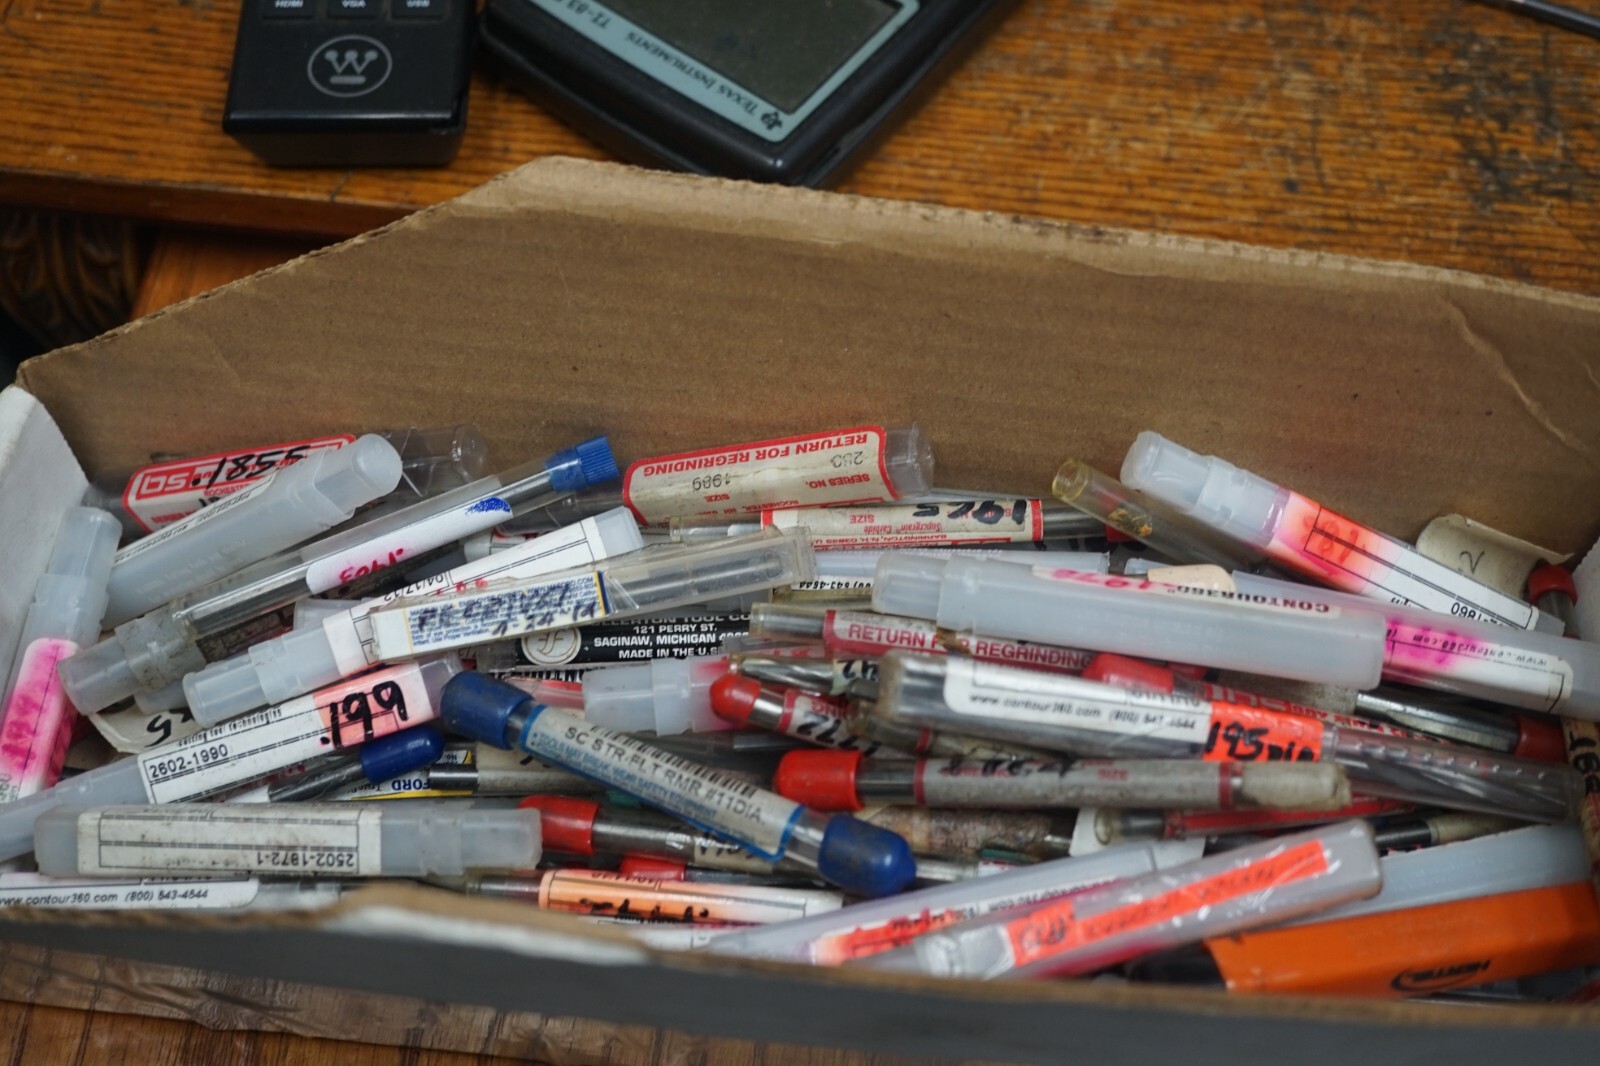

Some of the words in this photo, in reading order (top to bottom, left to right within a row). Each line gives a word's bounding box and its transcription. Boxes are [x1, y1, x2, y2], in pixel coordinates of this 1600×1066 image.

[625, 30, 717, 91] INSTRUMENTS
[718, 83, 761, 116] TEXAS
[754, 445, 792, 461] FOR
[794, 433, 869, 457] RETURN
[642, 450, 752, 478] REGRINDING
[804, 477, 827, 489] NO.
[826, 473, 871, 487] SERIES
[703, 493, 731, 504] SIZE
[849, 514, 875, 525] SIZE
[863, 523, 893, 536] Carbide
[632, 625, 655, 634] 121
[658, 623, 698, 633] PERRY
[699, 622, 718, 633] ST.
[593, 635, 654, 649] SAGINAW,
[655, 633, 717, 646] MICHIGAN
[849, 623, 927, 648] RETURN
[974, 638, 1094, 670] REGRINDING
[618, 648, 653, 659] MADE
[656, 648, 670, 658] IN
[672, 647, 697, 657] THE
[228, 707, 283, 732] technologies
[319, 680, 409, 750] .199
[564, 726, 590, 744] SC
[662, 768, 703, 797] RMR
[124, 890, 153, 903] (800)
[157, 888, 209, 901] 543-4544
